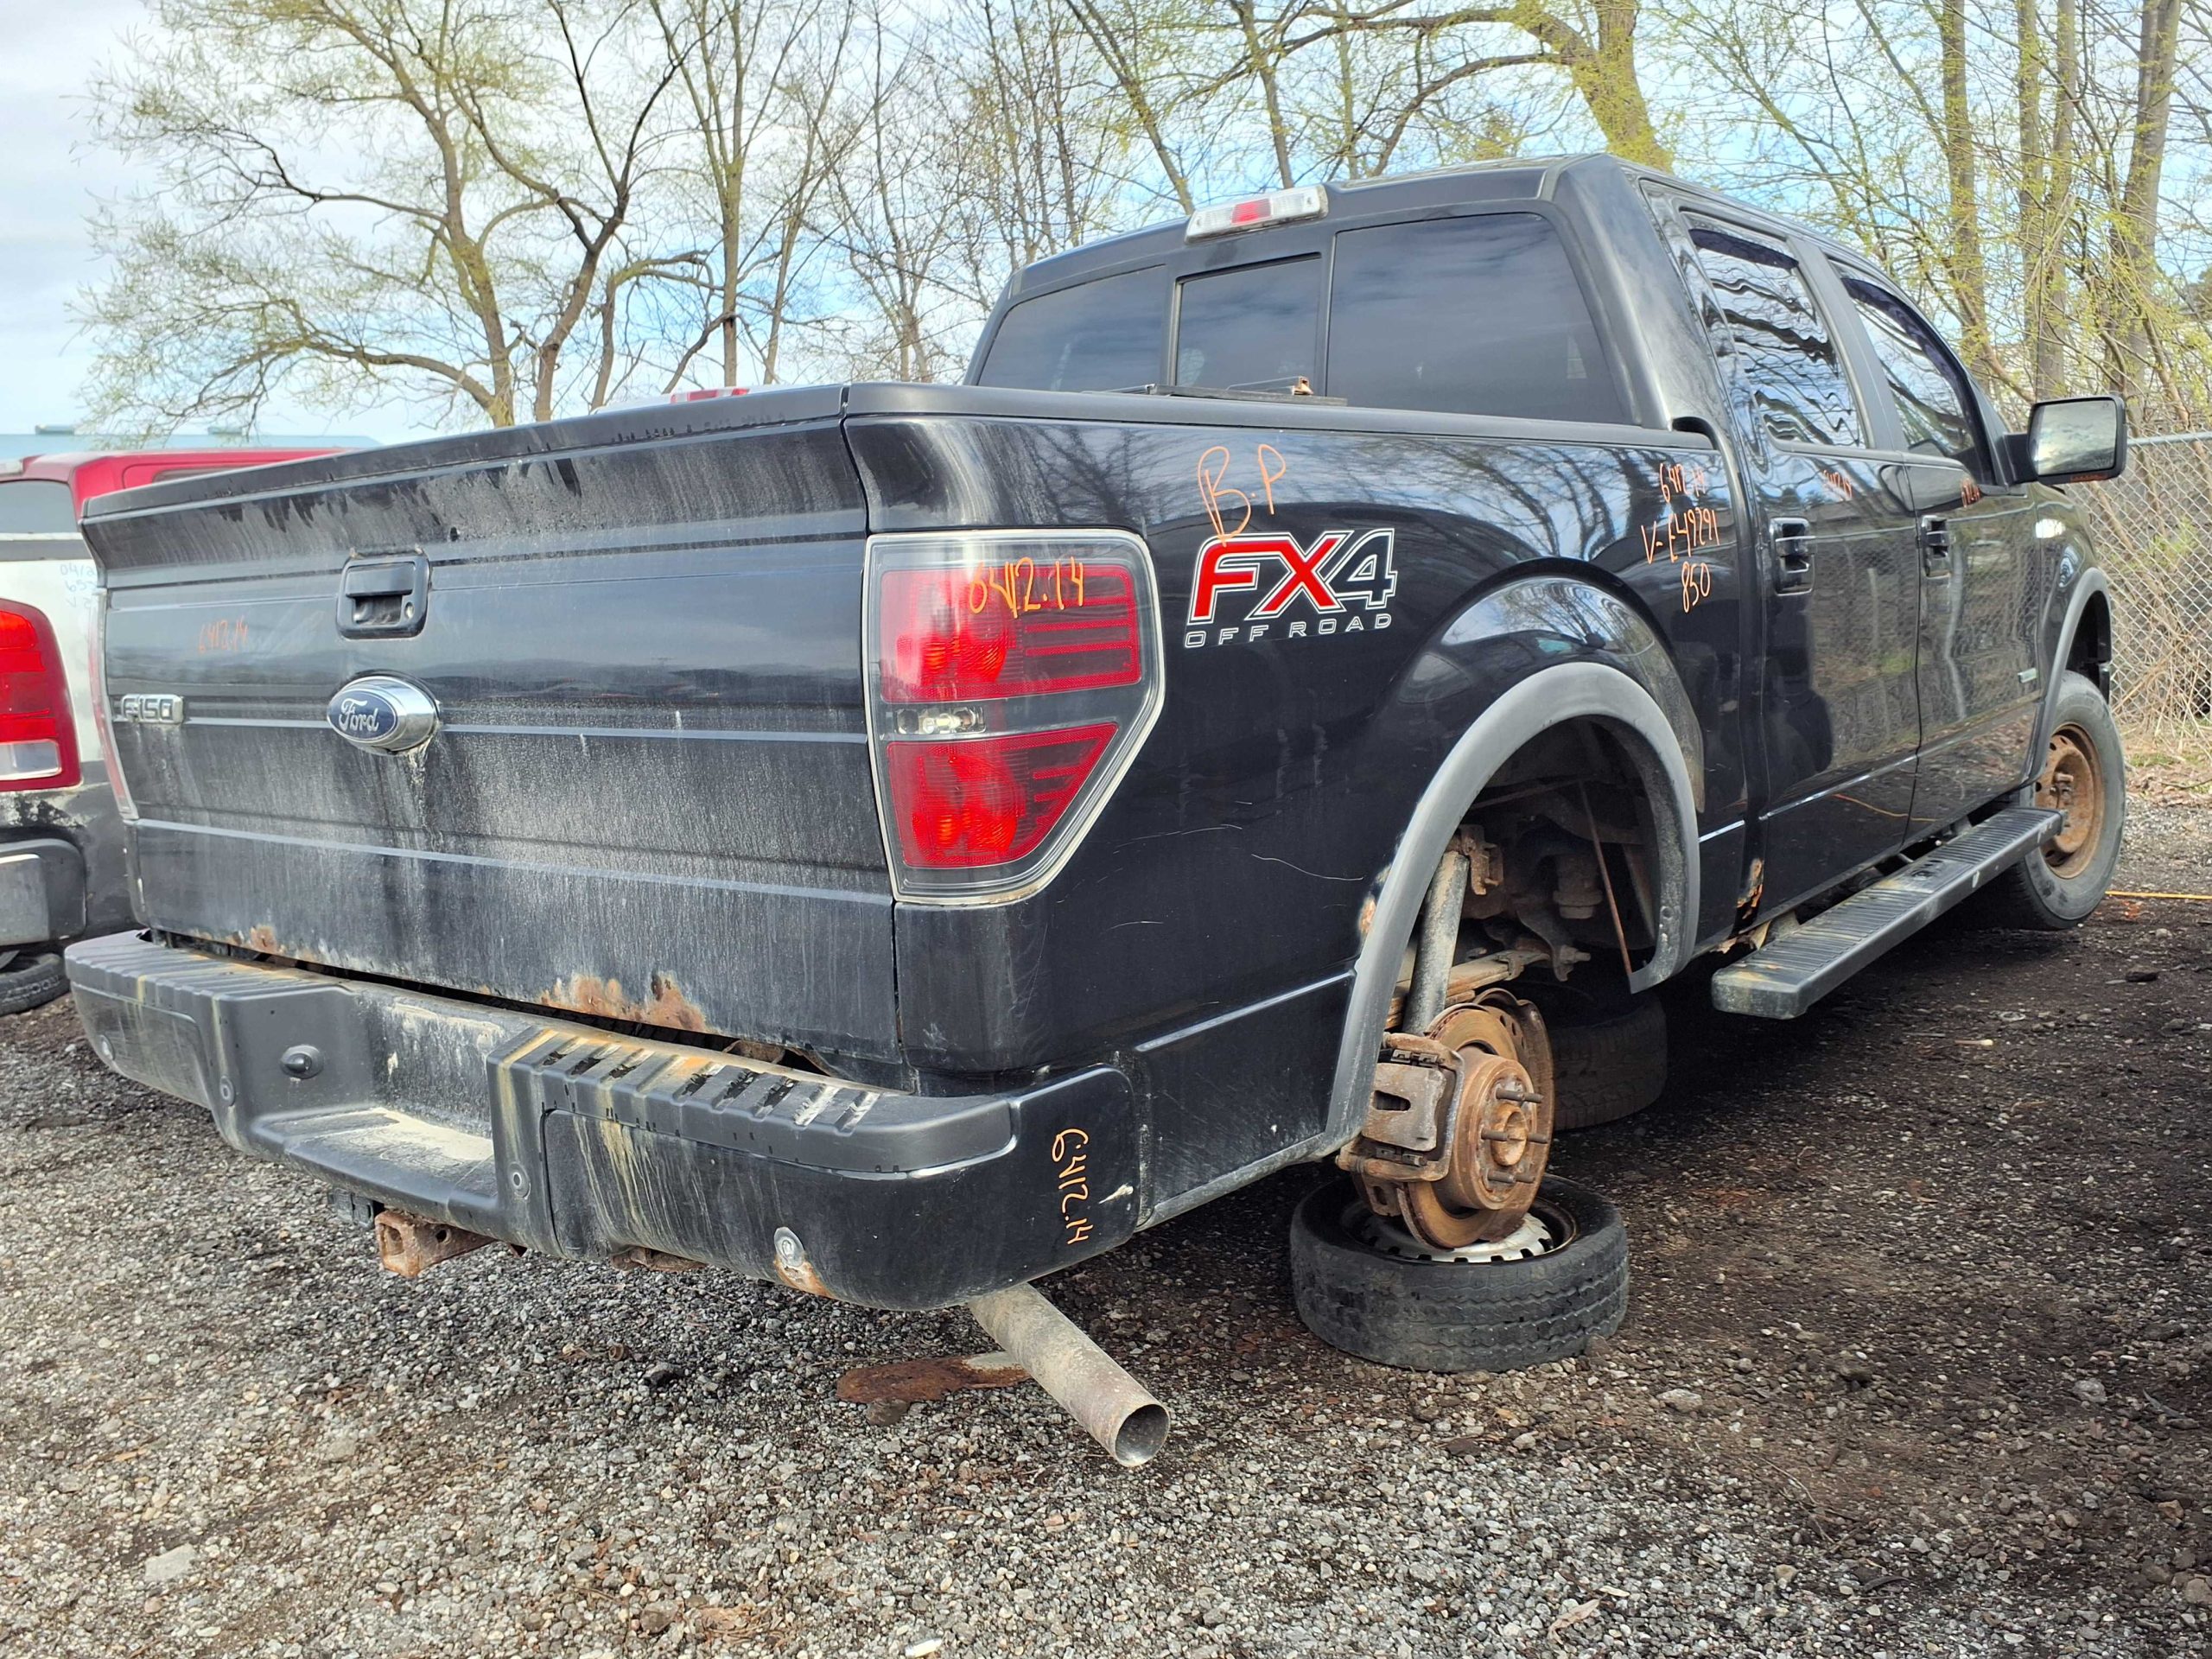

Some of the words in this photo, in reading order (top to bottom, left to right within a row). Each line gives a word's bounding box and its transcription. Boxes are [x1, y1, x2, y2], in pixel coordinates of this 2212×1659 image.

[1186, 528, 1398, 626] FX4
[1681, 561, 1711, 613] 850
[1185, 625, 1269, 648] OFF
[1288, 613, 1392, 638] ROAD
[338, 697, 380, 732] Ford
